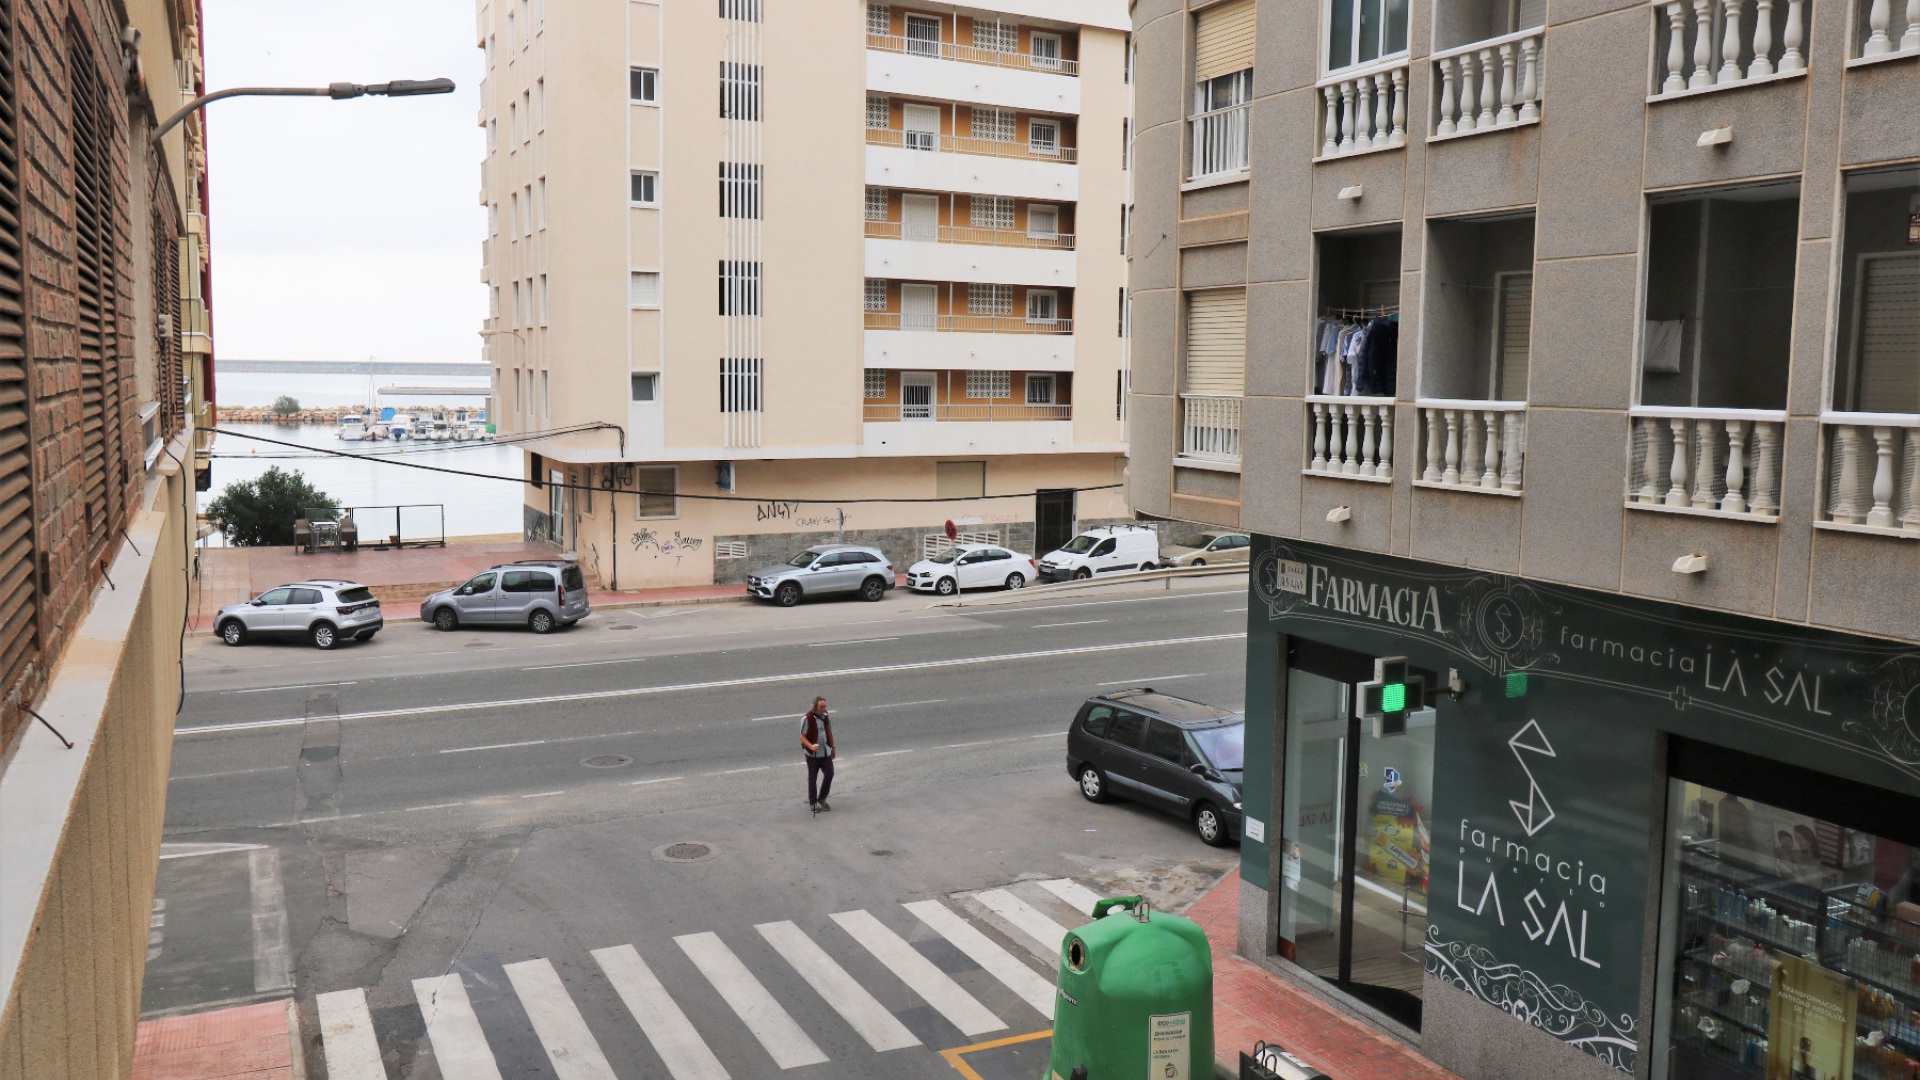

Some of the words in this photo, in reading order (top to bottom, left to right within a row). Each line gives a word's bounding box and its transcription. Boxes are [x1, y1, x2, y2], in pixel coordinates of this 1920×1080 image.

[1309, 564, 1445, 633] FARMACIA
[1561, 626, 1694, 673] farmacia
[1705, 653, 1747, 697] LA
[1764, 666, 1832, 715] SAL
[1460, 819, 1606, 895] farmacia
[1457, 860, 1505, 926] LA
[1522, 888, 1601, 968] SAL
